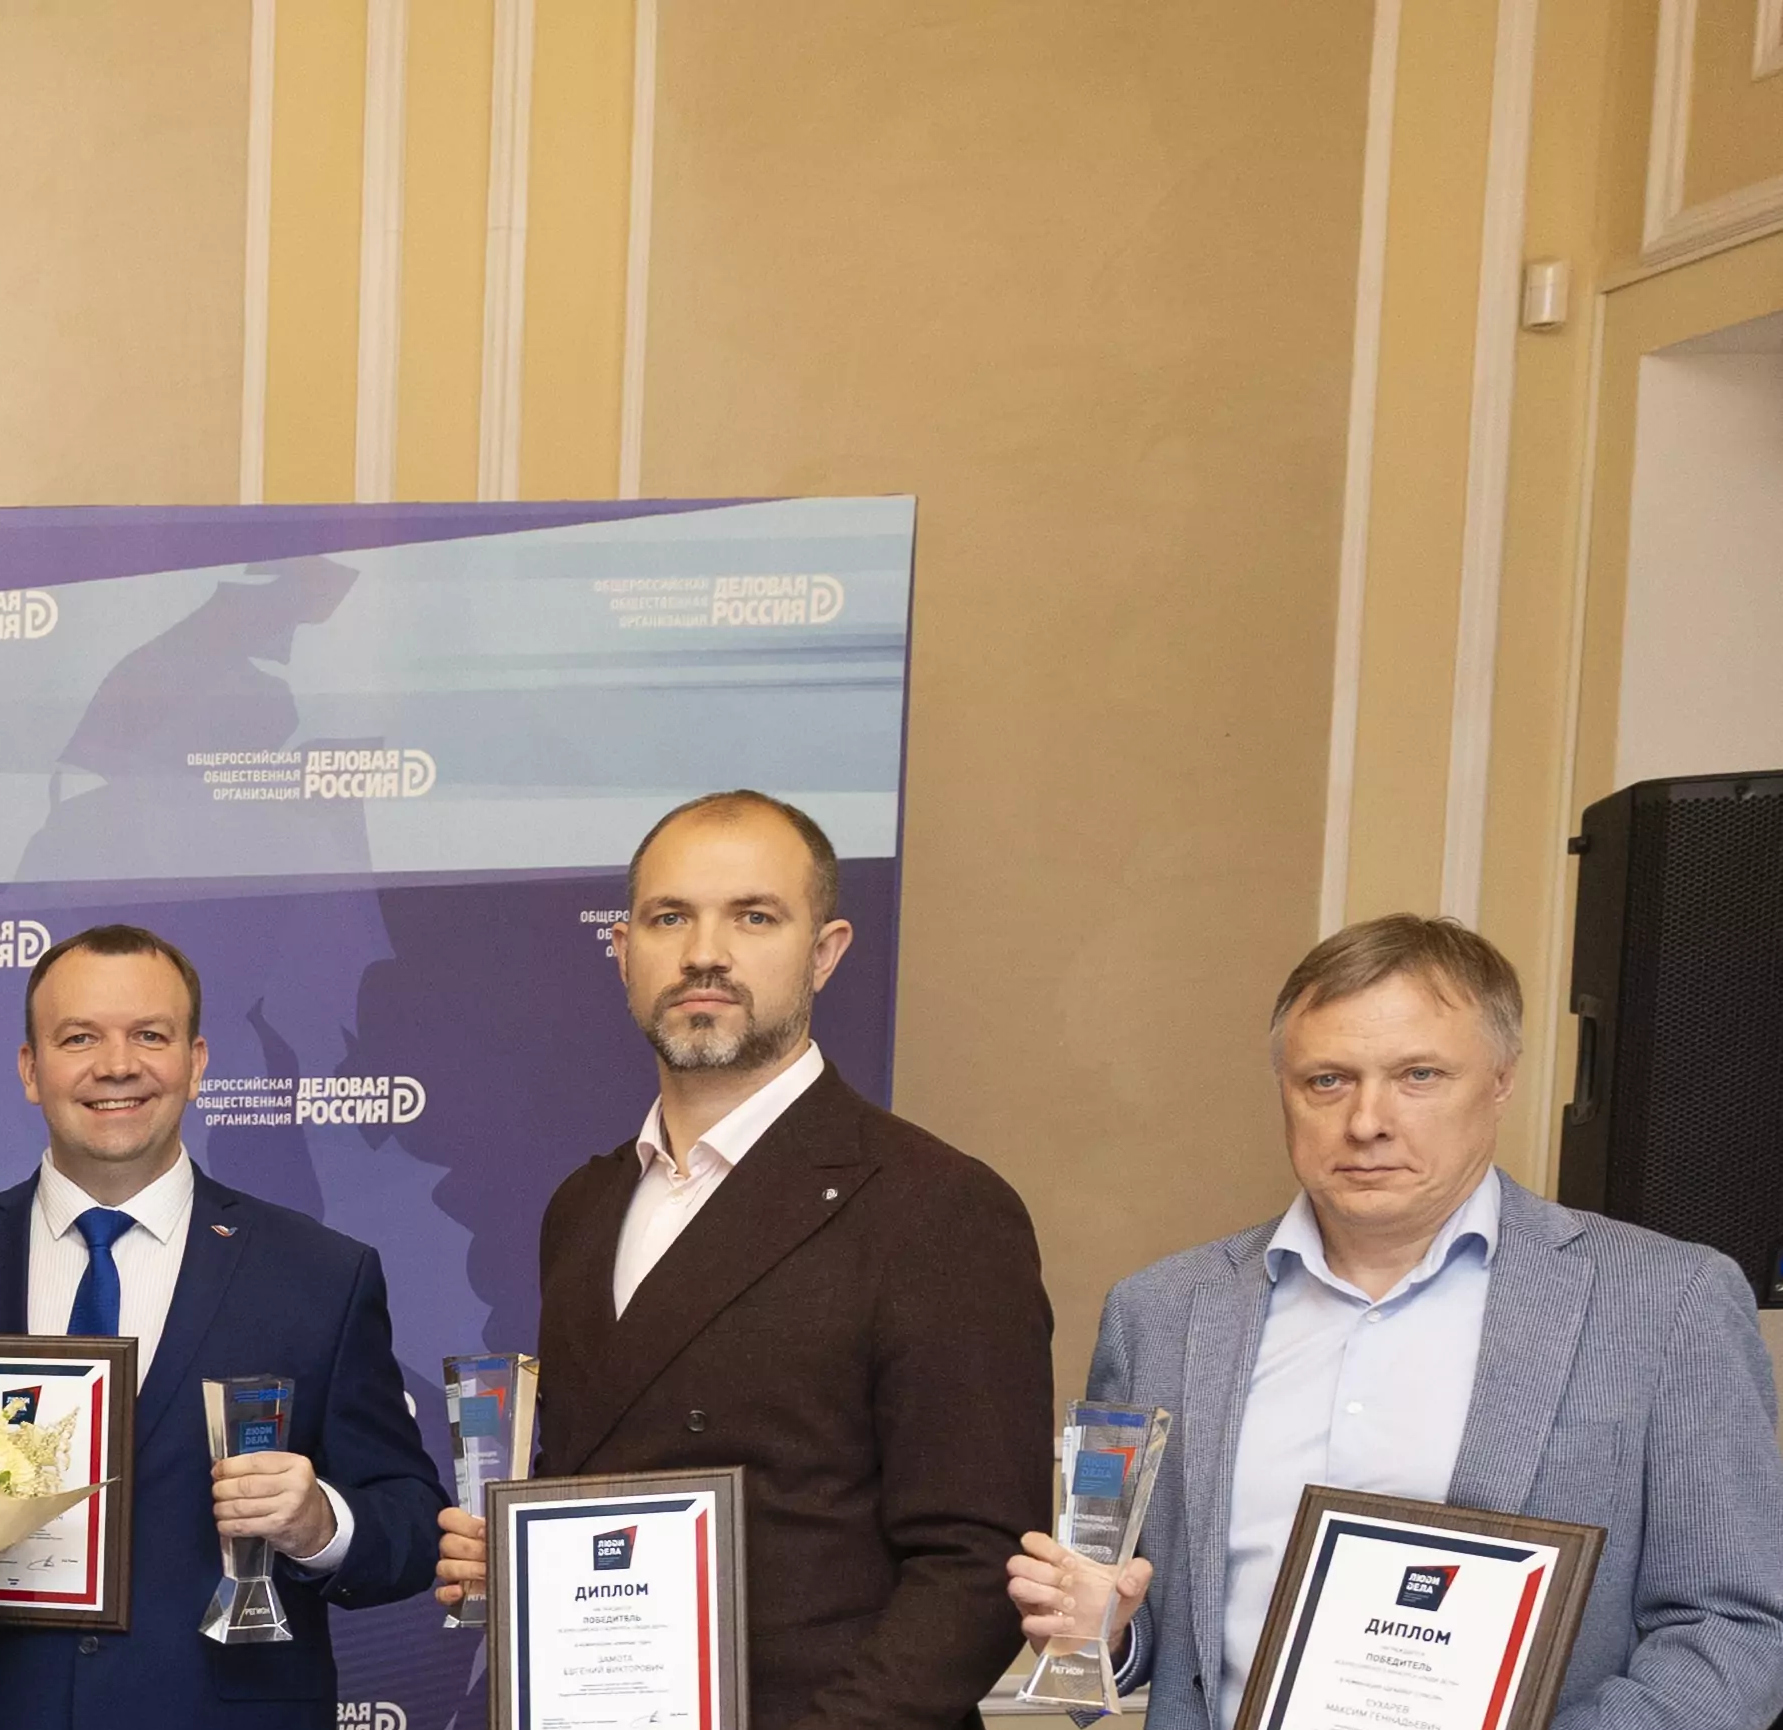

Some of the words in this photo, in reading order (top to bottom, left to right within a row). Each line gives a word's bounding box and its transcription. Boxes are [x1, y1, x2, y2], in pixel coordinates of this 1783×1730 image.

[712, 576, 805, 602] ДЕЛОВАЯ
[712, 599, 806, 625] РОССИЯ
[188, 750, 302, 767] ОБЩЕРОССИЙСКАЯ
[305, 750, 398, 774] ДЕЛОВАЯ
[204, 768, 301, 784] ОБЩЕСТВЕННАЯ
[213, 786, 301, 801] ОРГАНИЗАЦИЯ
[305, 773, 399, 798] РОССИЯ
[198, 1077, 292, 1092] ЩЕРОССИЙСКАЯ
[296, 1075, 389, 1100] ДЕЛОВАЯ
[196, 1096, 292, 1110] ОБЩЕСТВЕННАЯ
[296, 1098, 389, 1124] РОССИЯ
[206, 1113, 291, 1127] ОРГАНИЗАЦИЯ
[575, 1583, 648, 1601] ДИПЛОМ
[583, 1614, 641, 1624] ПОБЕДИТЕЛЬ
[1364, 1618, 1452, 1645] ДИПЛОМ
[1050, 1664, 1085, 1676] РЕГИОН
[1365, 1652, 1433, 1672] ПОБЕДИТЕЛЬ
[1325, 1702, 1368, 1718] МАКСИМ
